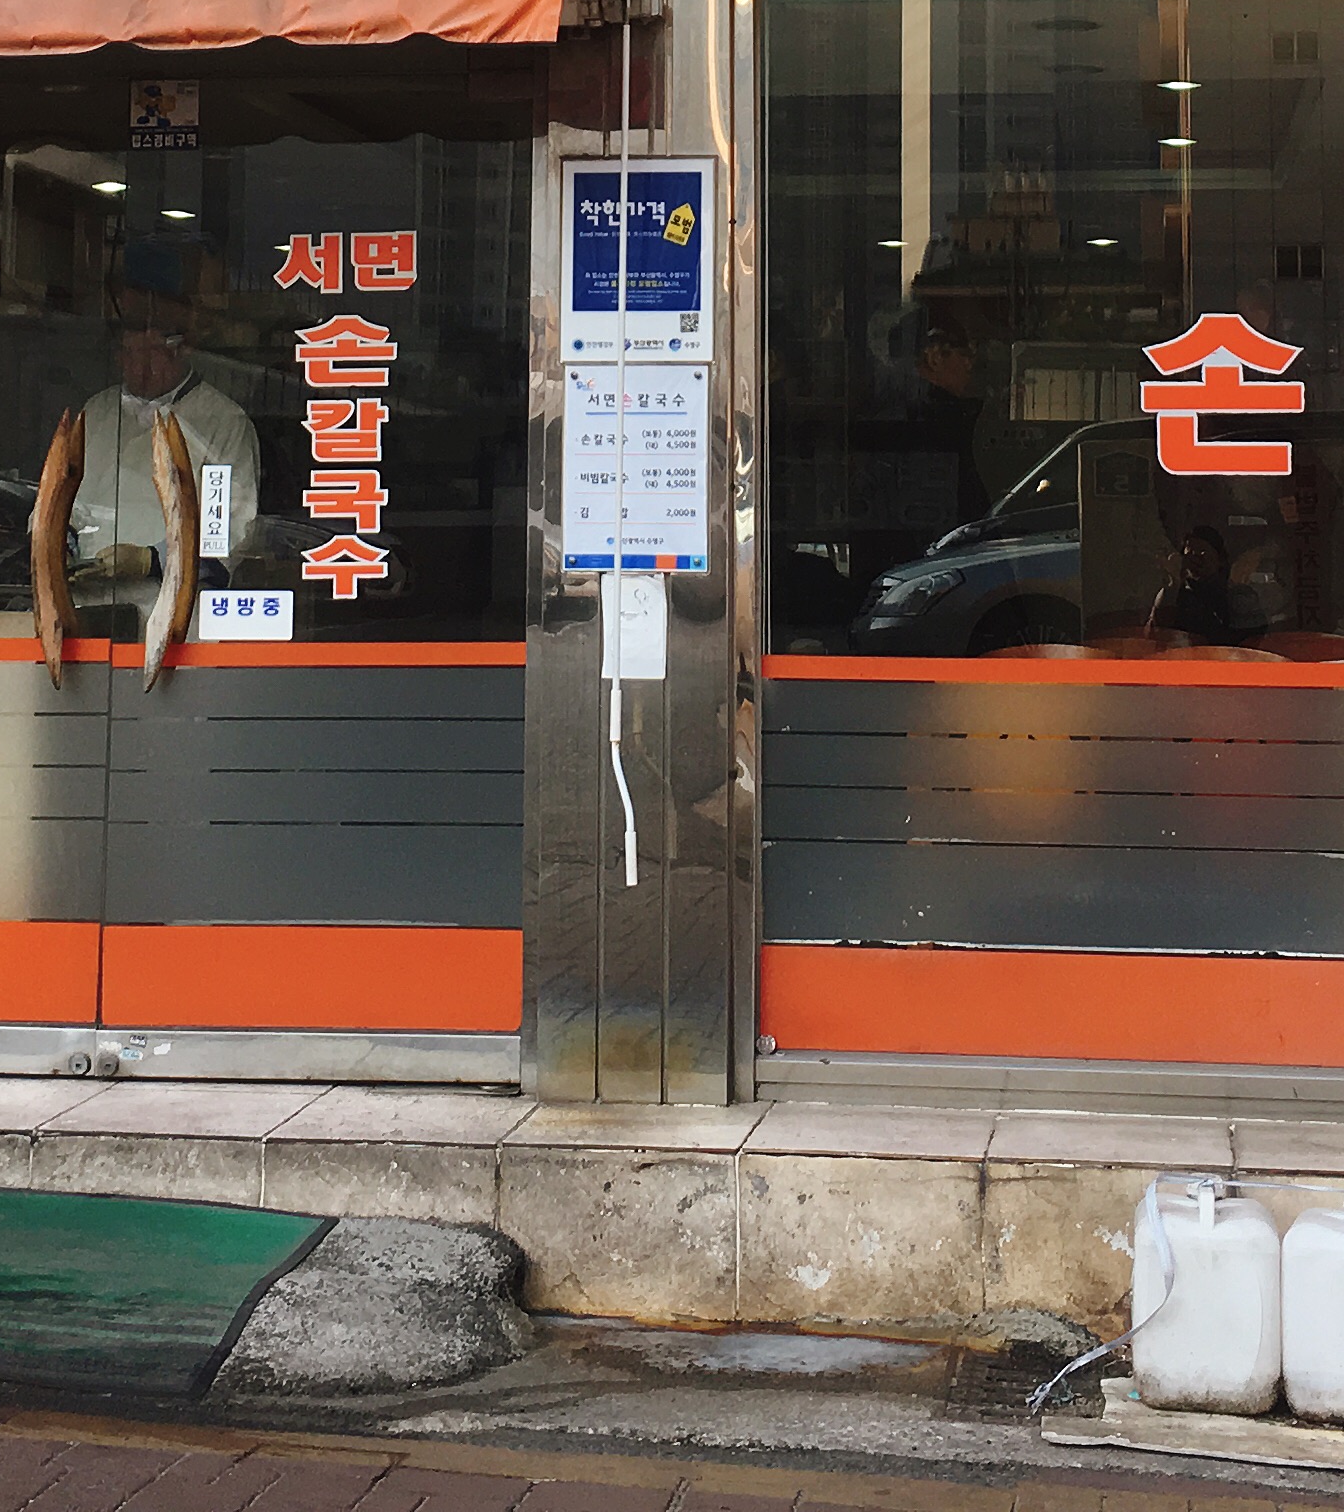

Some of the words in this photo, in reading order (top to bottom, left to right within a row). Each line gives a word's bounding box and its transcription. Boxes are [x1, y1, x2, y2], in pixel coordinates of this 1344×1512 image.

[274, 230, 418, 294] 서면
[294, 315, 398, 600] 손칼국수
[207, 470, 224, 535] 당기세요
[203, 541, 226, 550] PULL
[211, 597, 281, 617] 냉방중
